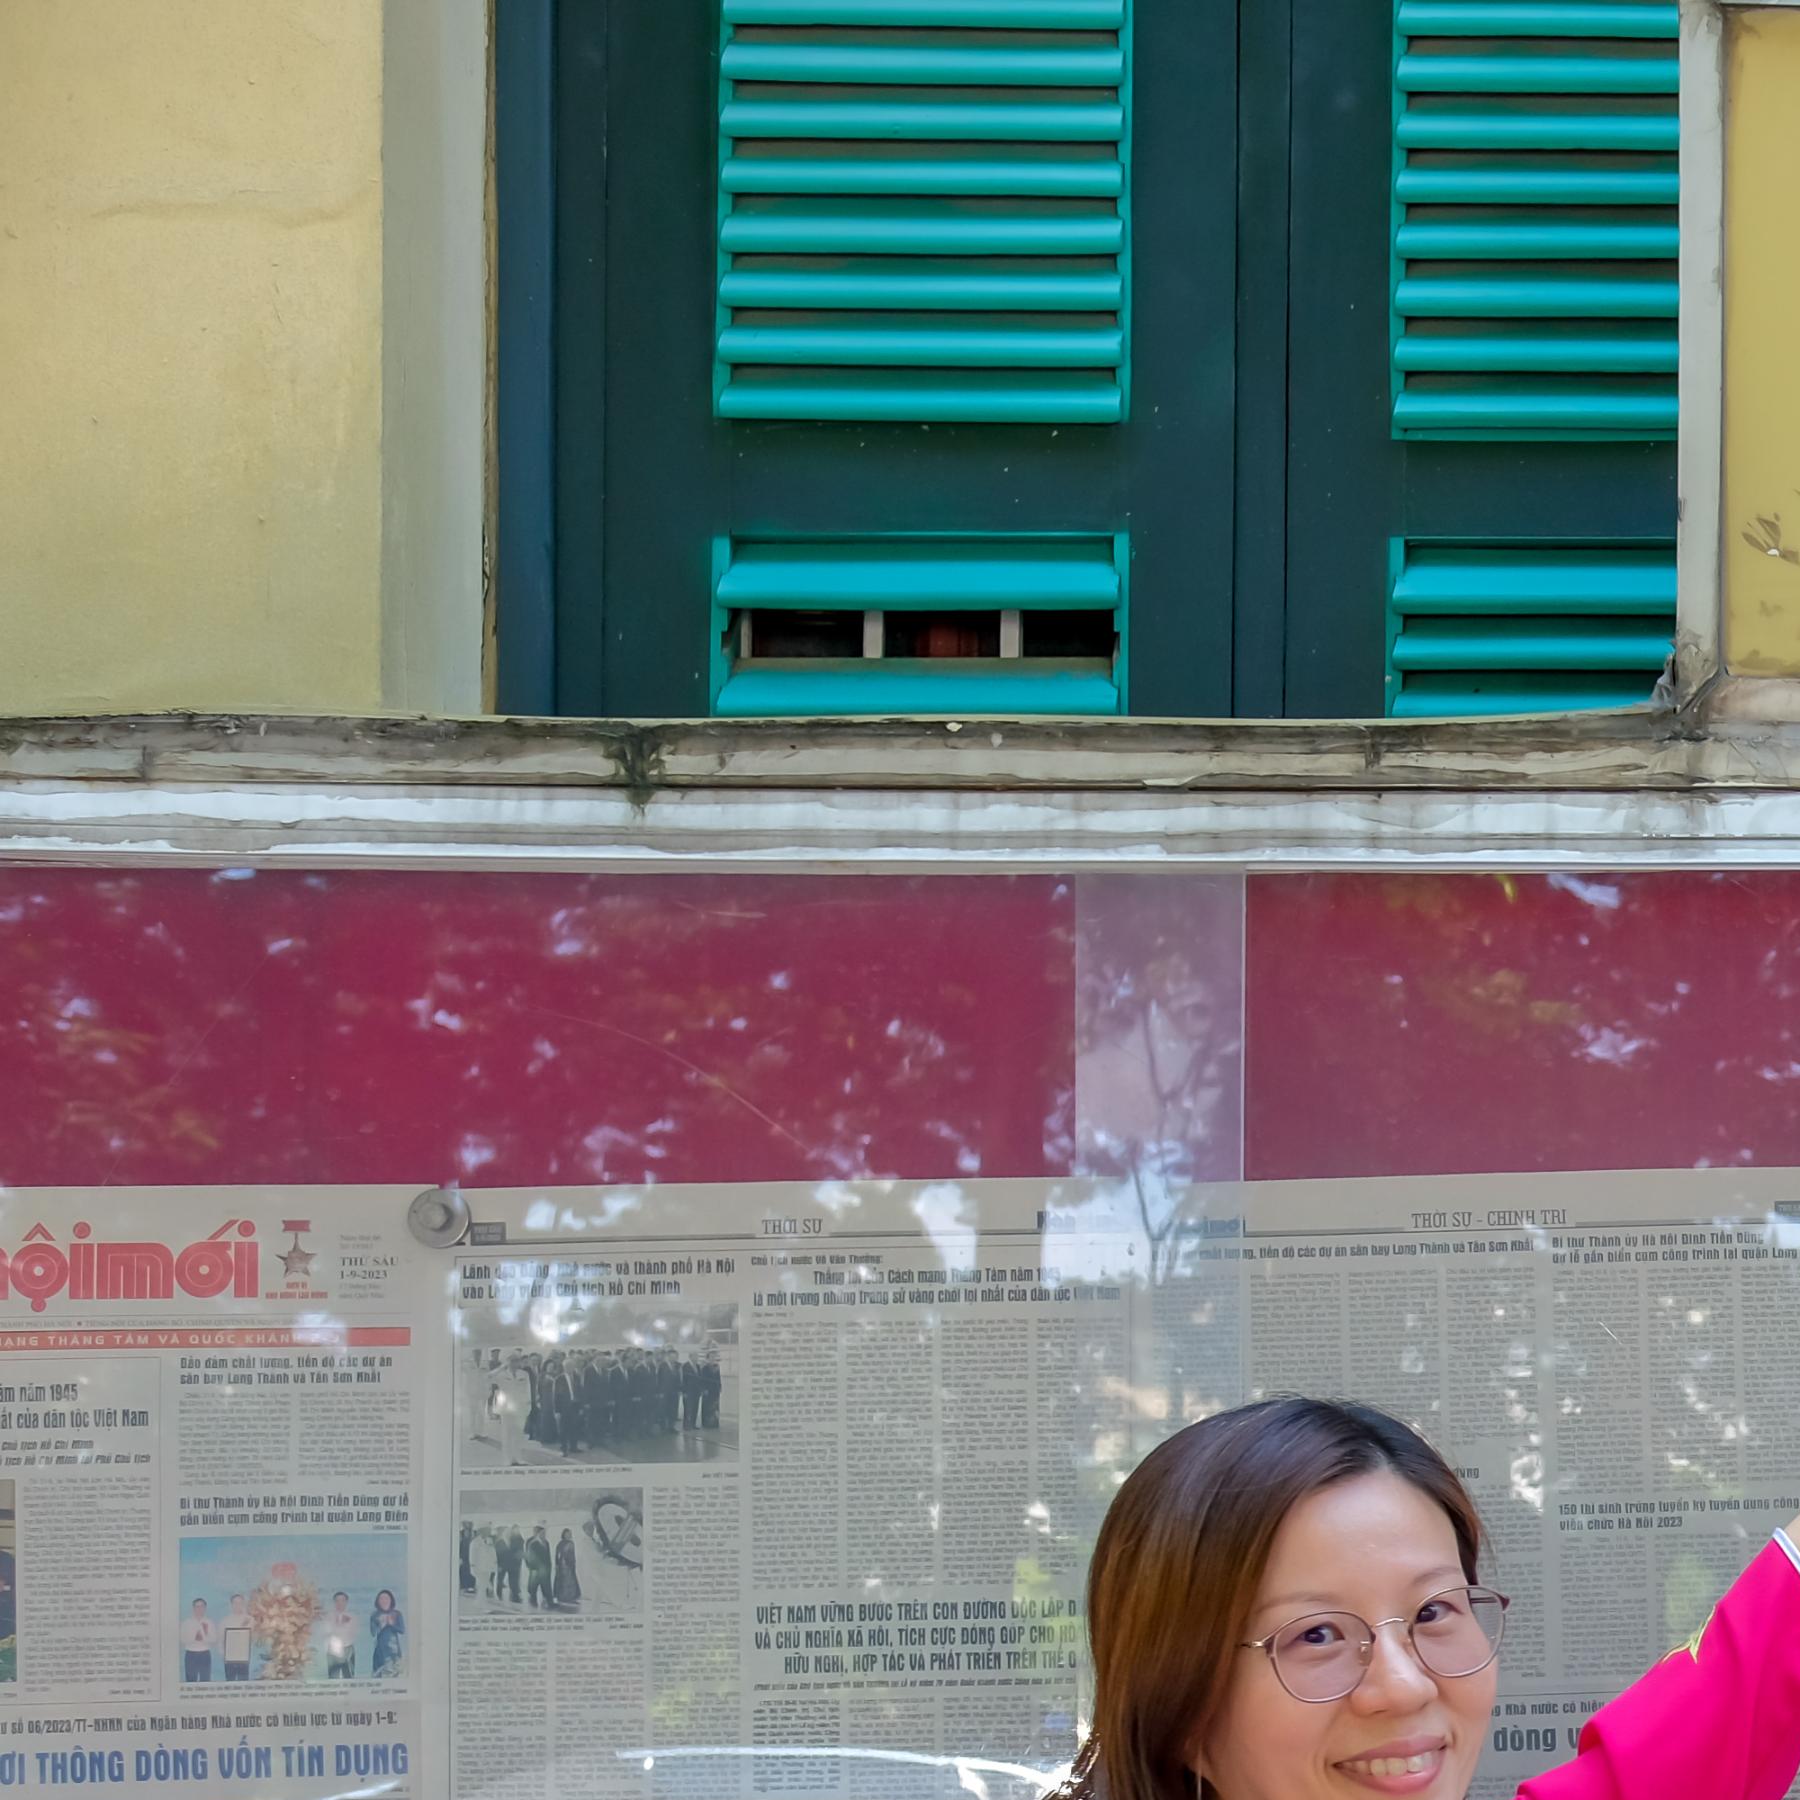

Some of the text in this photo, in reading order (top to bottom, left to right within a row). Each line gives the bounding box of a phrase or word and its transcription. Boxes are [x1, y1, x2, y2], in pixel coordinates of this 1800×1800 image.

[1411, 1212, 1447, 1228] THỜI
[0, 1219, 259, 1313] ộimới
[339, 1269, 388, 1281] 1-9-2023
[50, 1383, 78, 1402] 1945
[16, 1407, 149, 1432] của dân tộc Việt Nam
[756, 1604, 782, 1628] VIỆT
[786, 1604, 816, 1623] NAM
[821, 1600, 854, 1622] VỮNG
[859, 1601, 892, 1622] BƯỚC
[897, 1600, 928, 1621] TRÊN
[933, 1602, 958, 1620] CON
[963, 1598, 1006, 1619] ĐƯỜNG
[755, 1629, 771, 1649] VÀ
[776, 1626, 800, 1649] CHỦ
[805, 1627, 842, 1648] NGHĨA
[847, 1626, 863, 1647] XÃ
[898, 1627, 926, 1646] TÍCH
[931, 1627, 956, 1649] CỰC
[1000, 1623, 1025, 1644] GÓP
[1030, 1625, 1054, 1643] CHO
[784, 1652, 809, 1674] HỮU
[853, 1654, 878, 1677] HỢP
[883, 1650, 905, 1672] TÁC
[909, 1651, 925, 1671] VÀ
[930, 1650, 962, 1671] PHÁT
[966, 1648, 1000, 1670] TRIỂN
[127, 1715, 146, 1731] của
[346, 1711, 372, 1727] ngày
[35, 1734, 409, 1785] THÔNG DÒNG VỐN TÍN DỤNG
